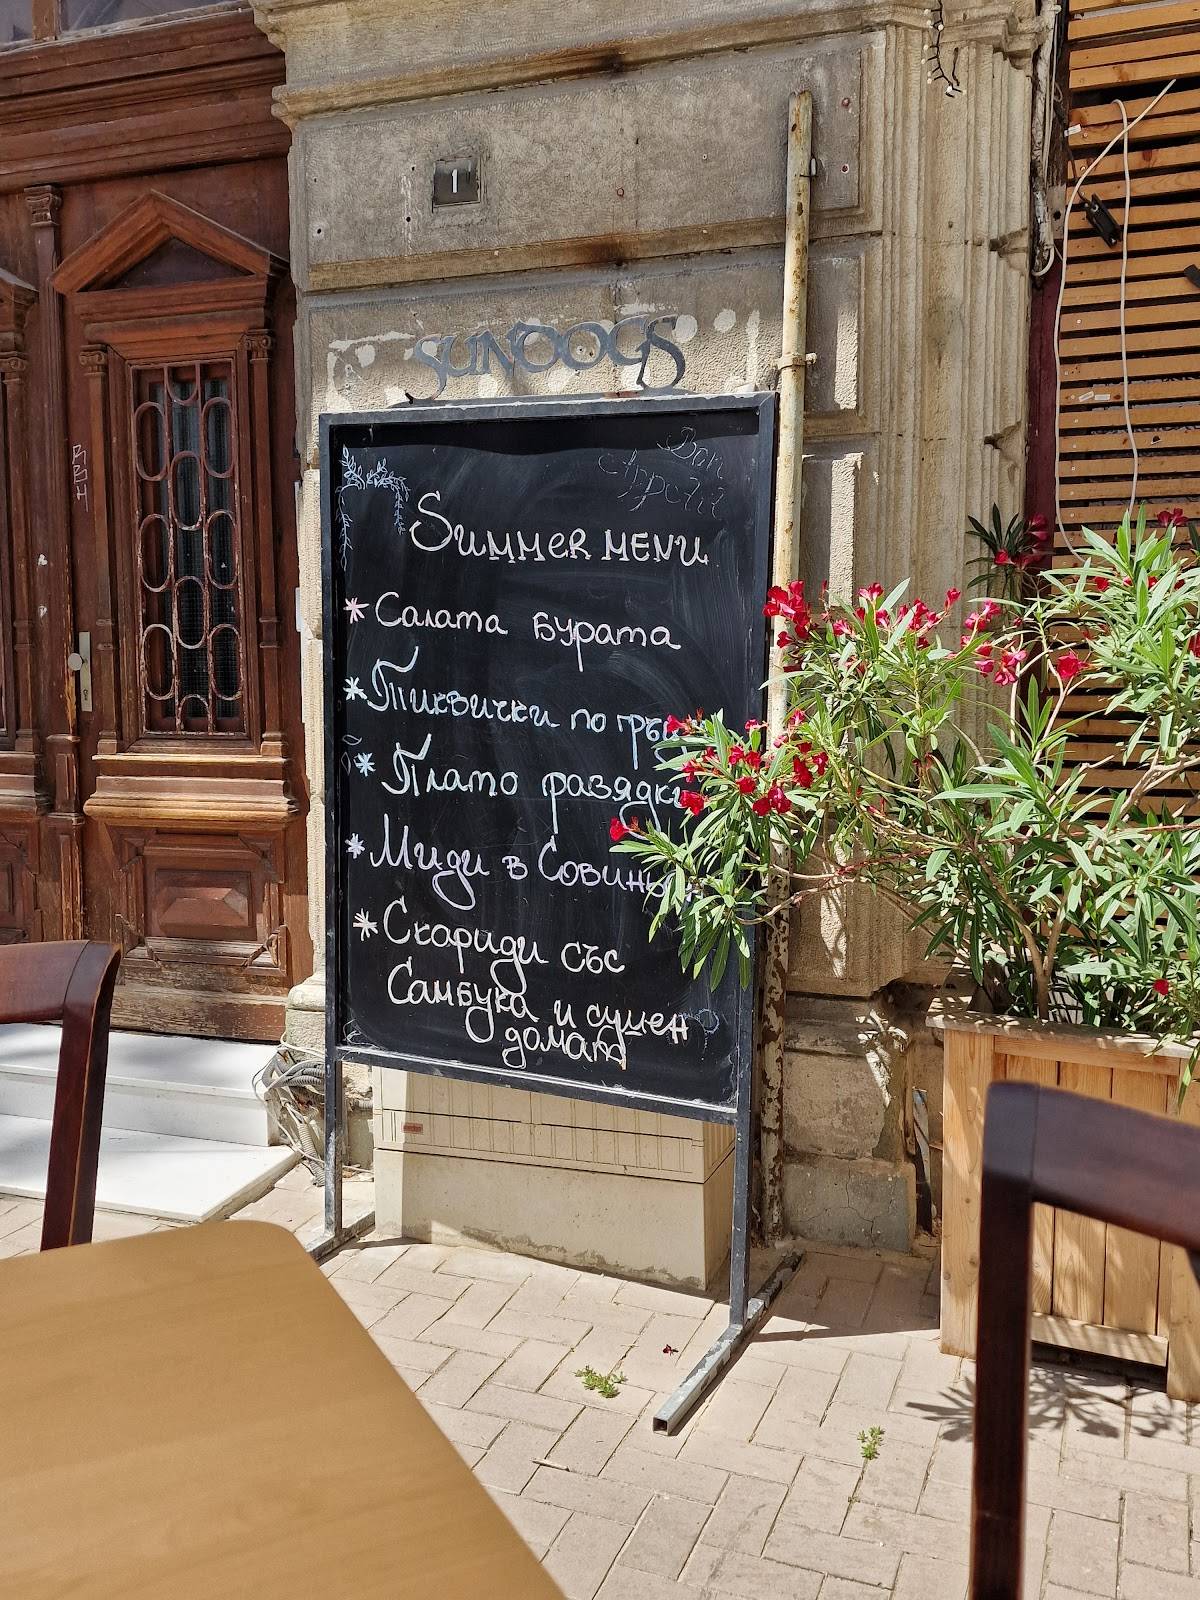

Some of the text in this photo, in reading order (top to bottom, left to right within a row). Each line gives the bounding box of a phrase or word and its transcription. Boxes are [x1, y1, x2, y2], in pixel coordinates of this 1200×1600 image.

[451, 168, 459, 194] 1
[374, 591, 508, 635] Салата
[571, 708, 607, 733] по
[381, 733, 518, 796] Плато
[369, 813, 490, 910] Миди
[502, 855, 528, 880] в
[383, 895, 626, 996] Скариди със
[554, 1000, 574, 1028] и
